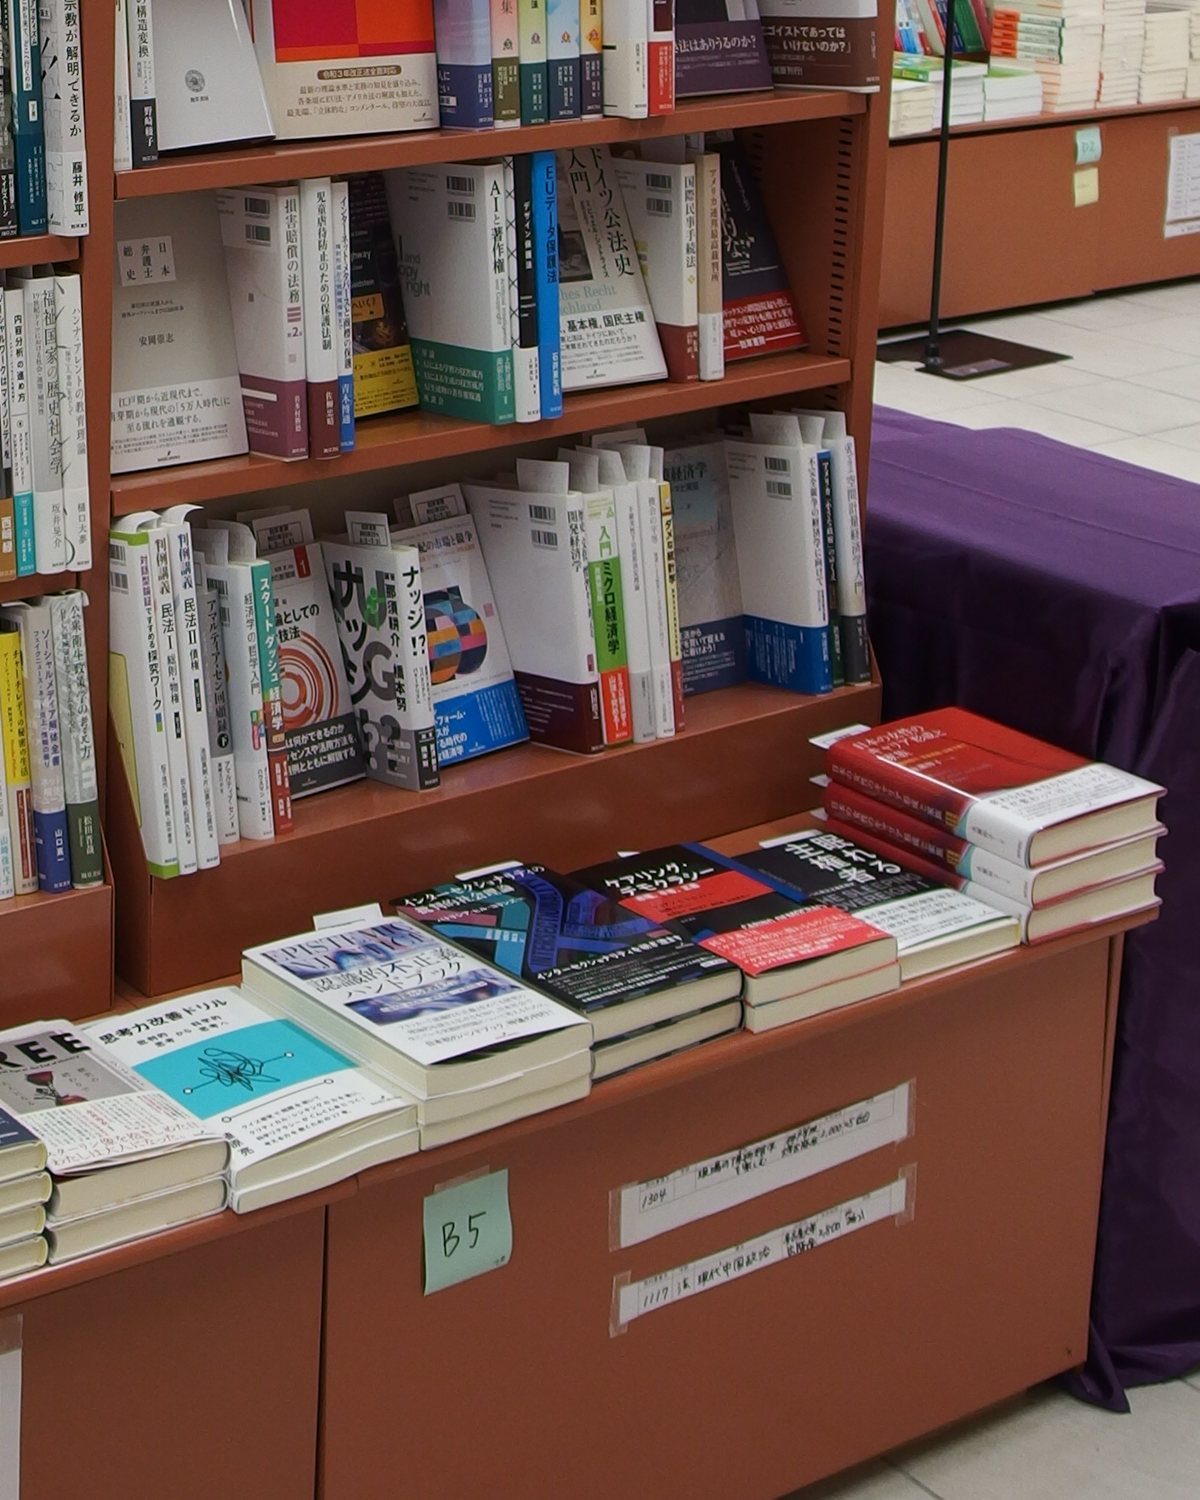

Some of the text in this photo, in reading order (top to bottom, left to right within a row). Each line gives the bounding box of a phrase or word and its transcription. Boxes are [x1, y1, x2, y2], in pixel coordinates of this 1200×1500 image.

[285, 199, 300, 304] 損害賠償の法務
[316, 191, 332, 351] 児童虐待防止のための保護法制
[42, 290, 63, 475] 福祉国家の歴史社会学
[603, 562, 621, 656] ミクロ経済学
[97, 997, 228, 1045] 思考力改善ドリル
[441, 1211, 487, 1258] B5
